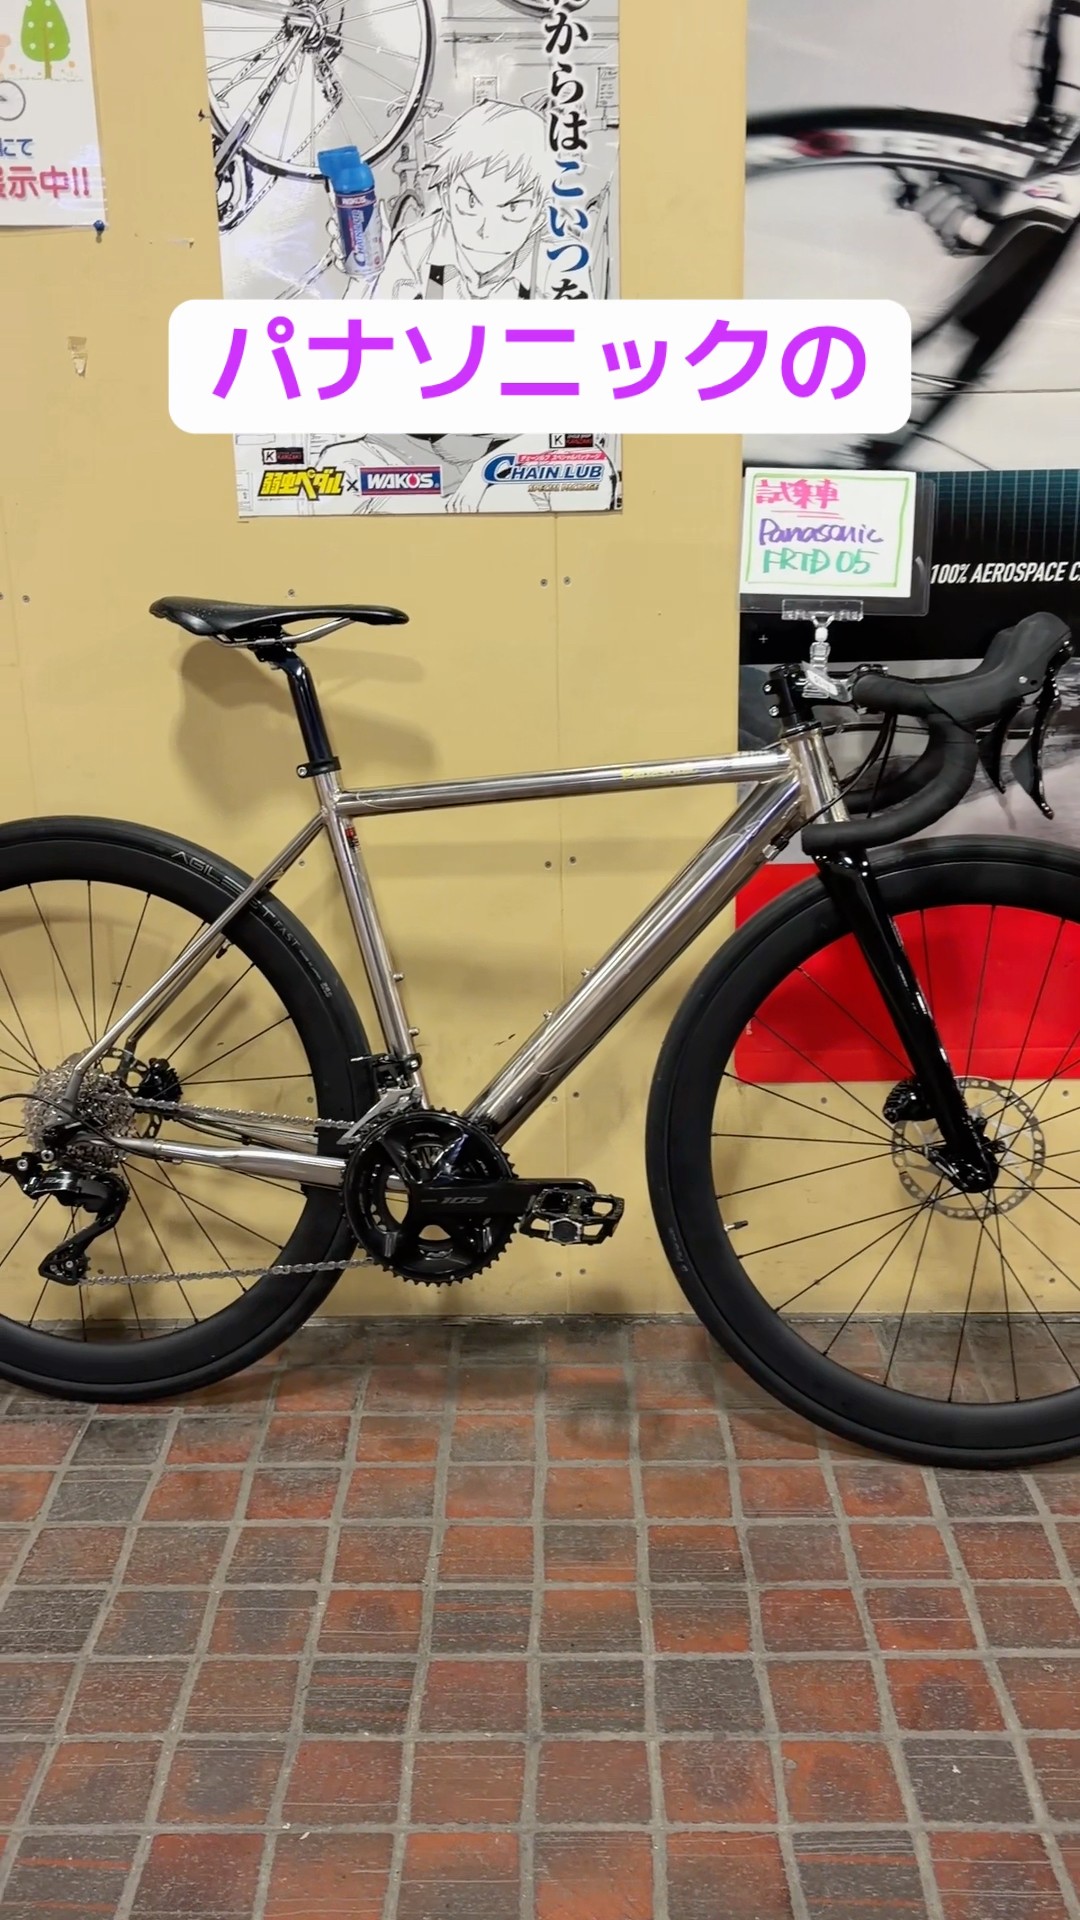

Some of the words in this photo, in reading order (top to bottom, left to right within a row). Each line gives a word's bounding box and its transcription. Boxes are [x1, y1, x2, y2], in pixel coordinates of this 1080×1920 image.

[0, 165, 89, 199] 示中!!
[484, 455, 558, 482] CHAIN
[564, 465, 603, 479] LUB
[259, 467, 344, 500] 弱虫ペダル
[367, 472, 434, 490] WAKO'S
[756, 479, 840, 509] 試乗車
[759, 518, 884, 546] Panasonic
[930, 563, 971, 584] 100%
[969, 562, 1069, 583] AEROSPACE
[1068, 561, 1080, 582] C
[273, 920, 302, 947] FAST
[441, 1196, 488, 1205] 105
